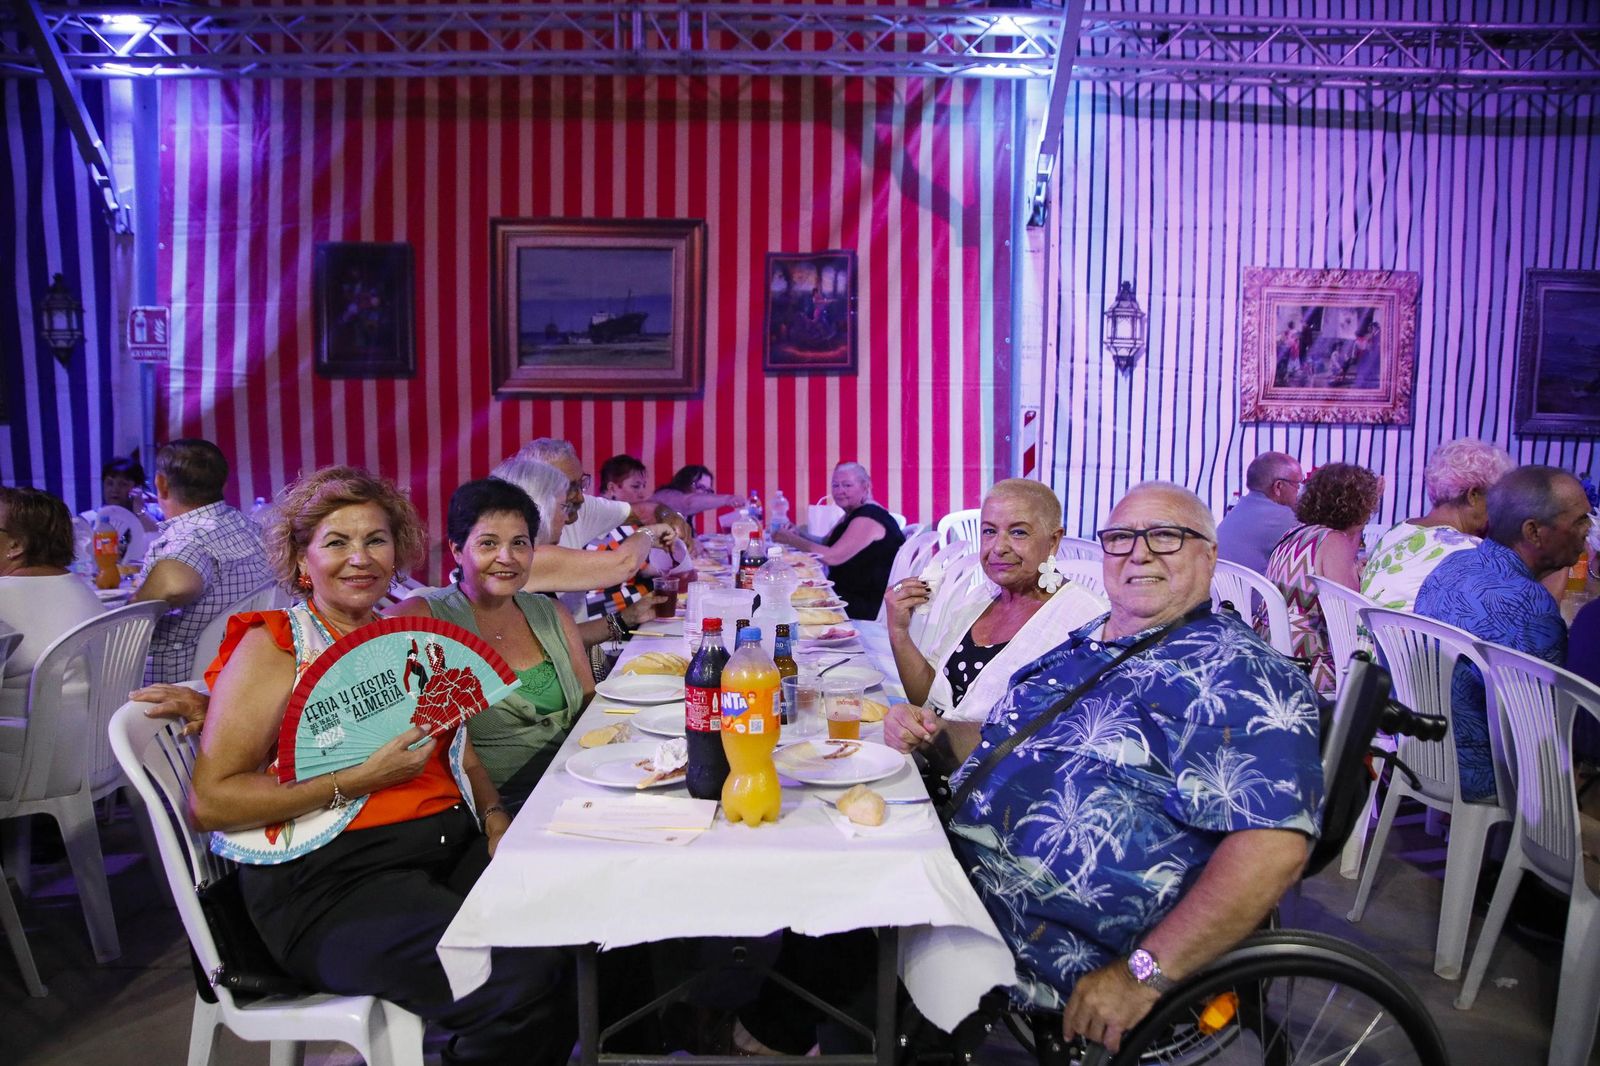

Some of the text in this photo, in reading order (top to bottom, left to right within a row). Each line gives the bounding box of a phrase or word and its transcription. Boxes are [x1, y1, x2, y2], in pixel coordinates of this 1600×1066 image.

[338, 690, 350, 705] Y
[350, 669, 397, 701] FIESTAS
[315, 726, 345, 748] 2024
